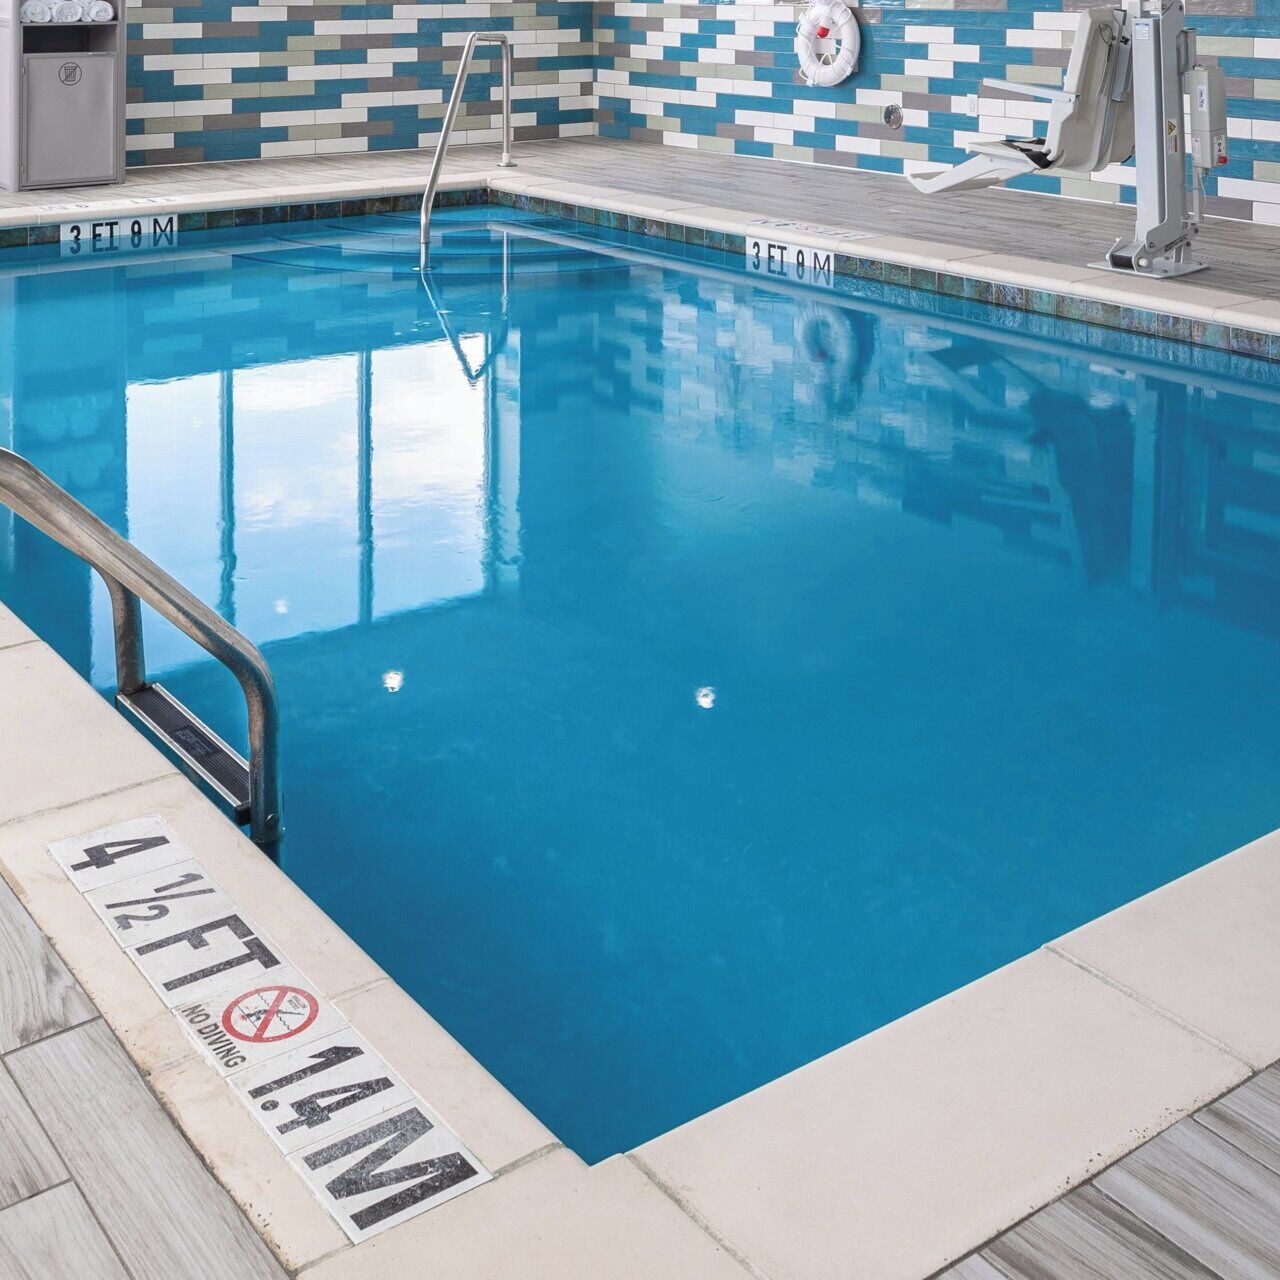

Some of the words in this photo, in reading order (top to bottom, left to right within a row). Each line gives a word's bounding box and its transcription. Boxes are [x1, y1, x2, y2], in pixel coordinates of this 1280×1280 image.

[91, 221, 118, 241] FT
[70, 835, 170, 872] 4
[134, 912, 282, 992] FT
[180, 1003, 212, 1035] NO
[197, 1023, 247, 1070] DIVING
